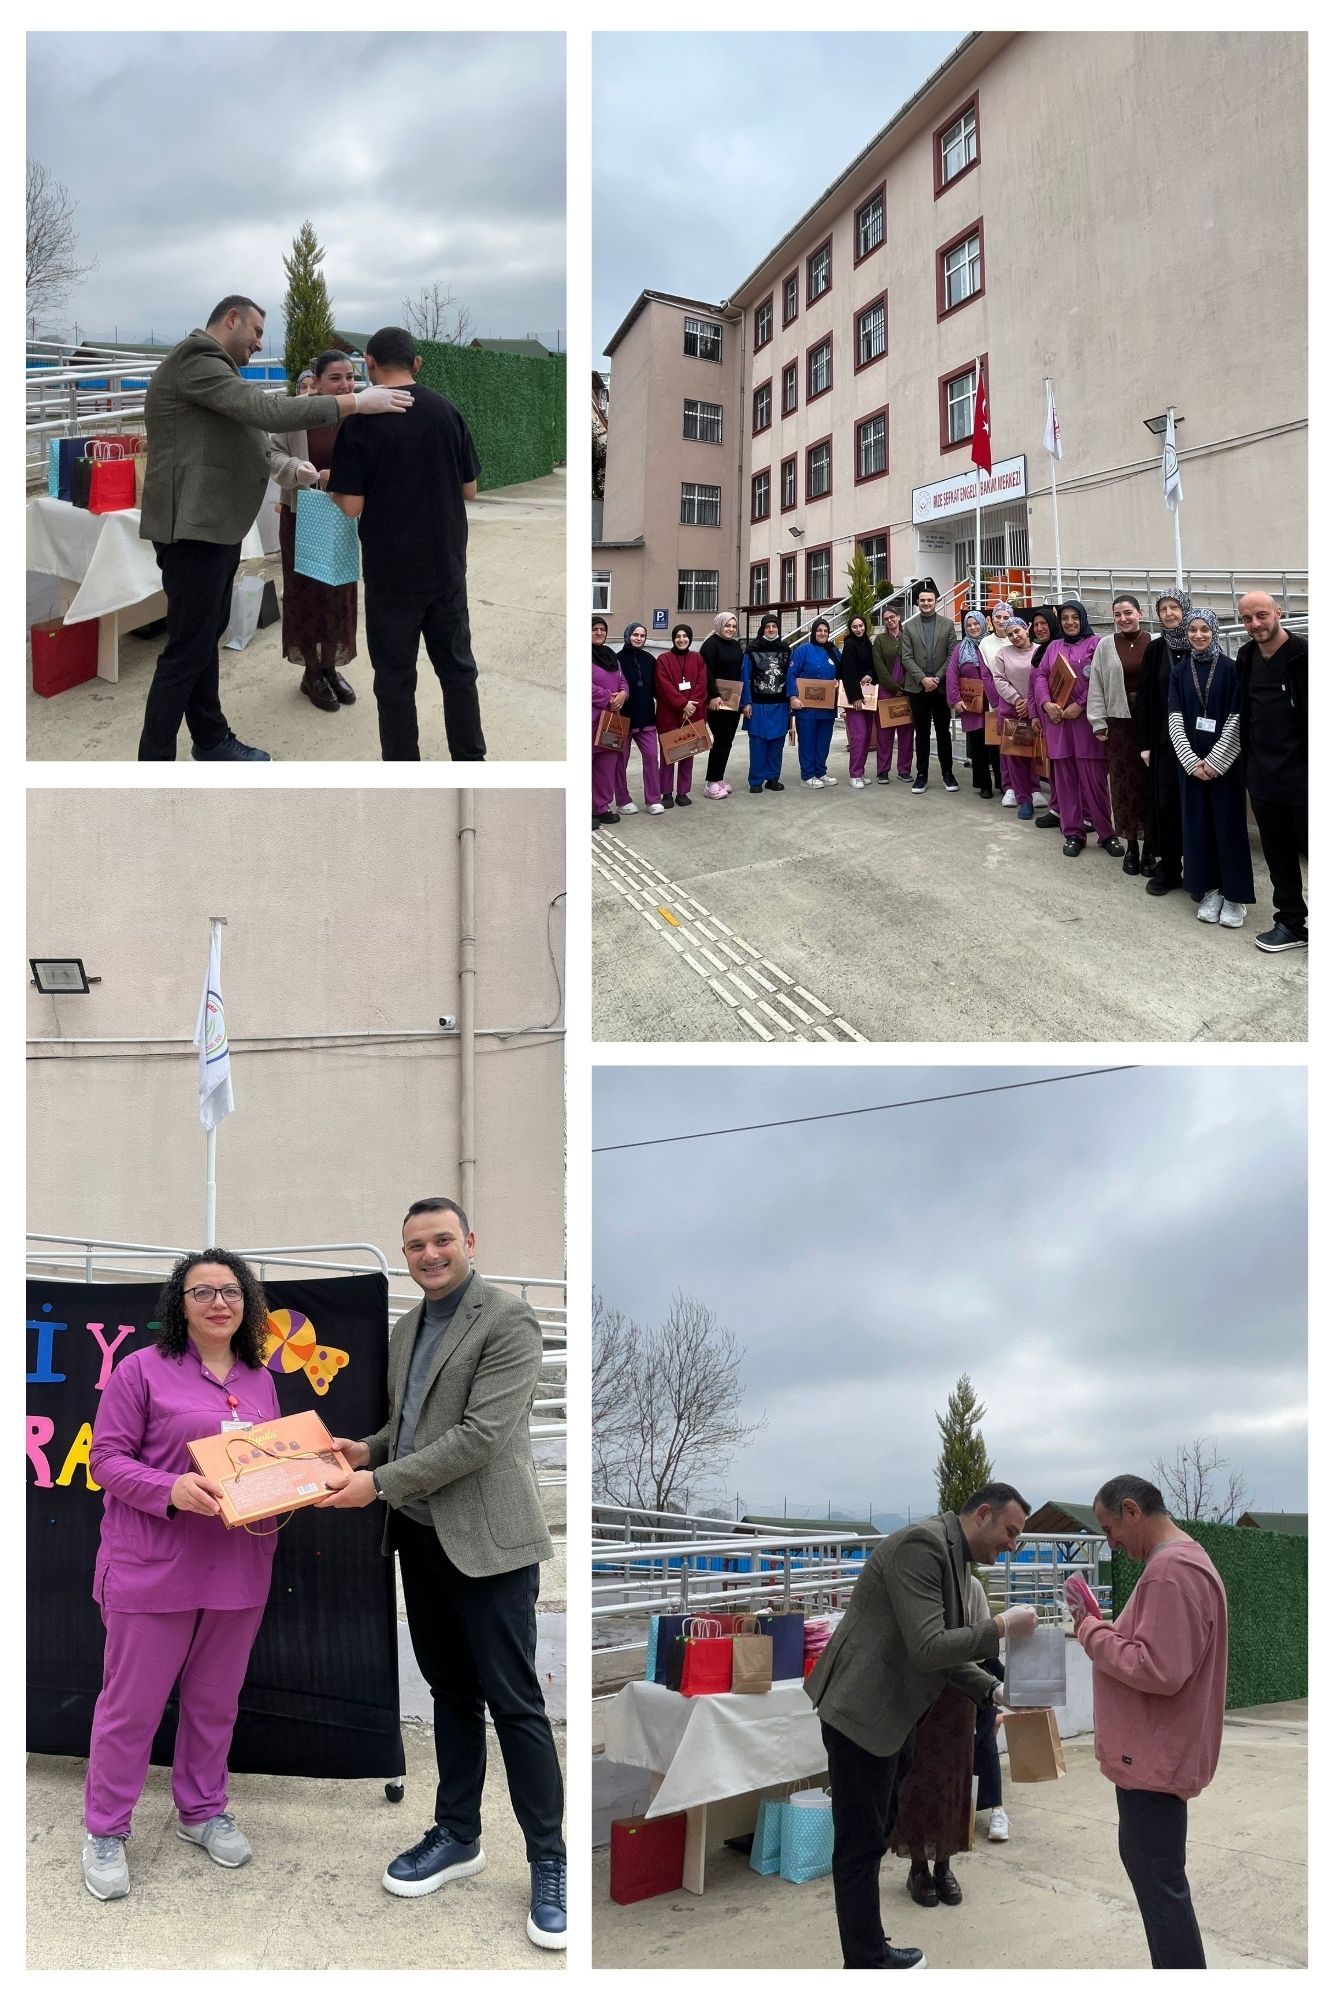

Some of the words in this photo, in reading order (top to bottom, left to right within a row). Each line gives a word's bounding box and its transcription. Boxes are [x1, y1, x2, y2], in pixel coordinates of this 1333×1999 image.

[980, 476, 997, 496] BAKIM
[997, 466, 1021, 491] MERKEZİ
[656, 611, 664, 622] P
